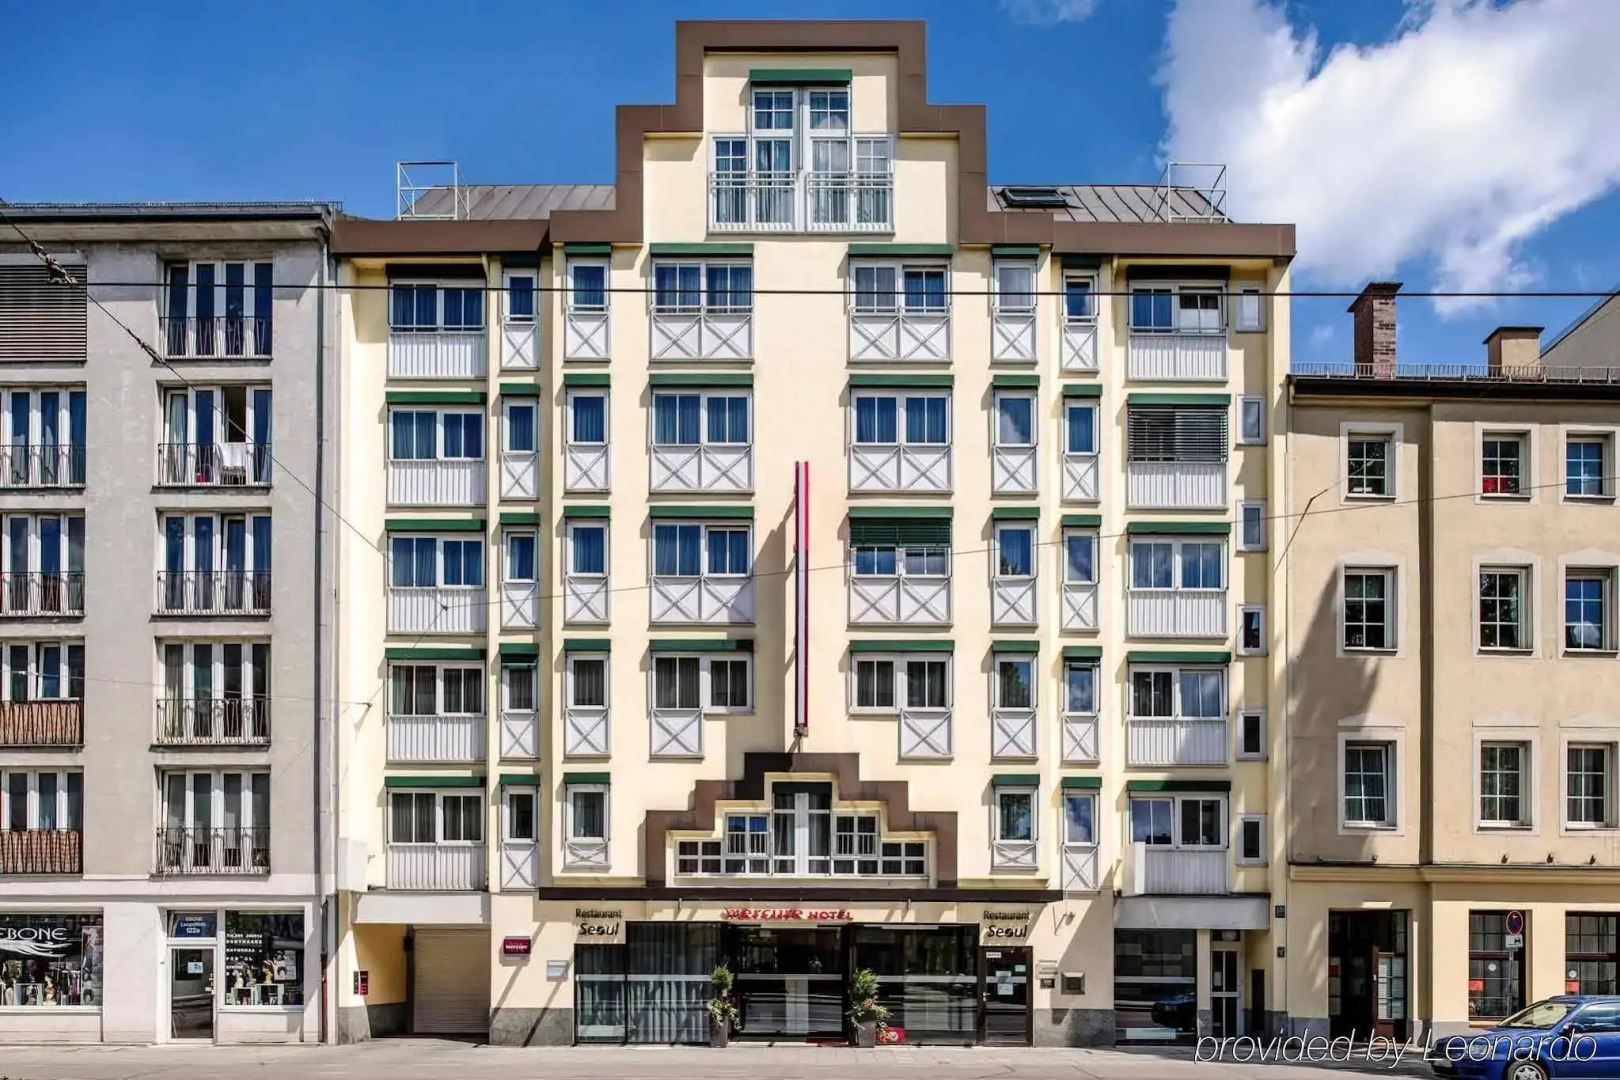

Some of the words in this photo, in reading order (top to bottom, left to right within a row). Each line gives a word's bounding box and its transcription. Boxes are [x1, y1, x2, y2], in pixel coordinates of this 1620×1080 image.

[575, 908, 622, 919] Restaurant
[808, 910, 854, 921] HOTEL
[983, 910, 1030, 920] Restaurant
[578, 921, 620, 936] Seoul
[987, 924, 1028, 938] Seoul
